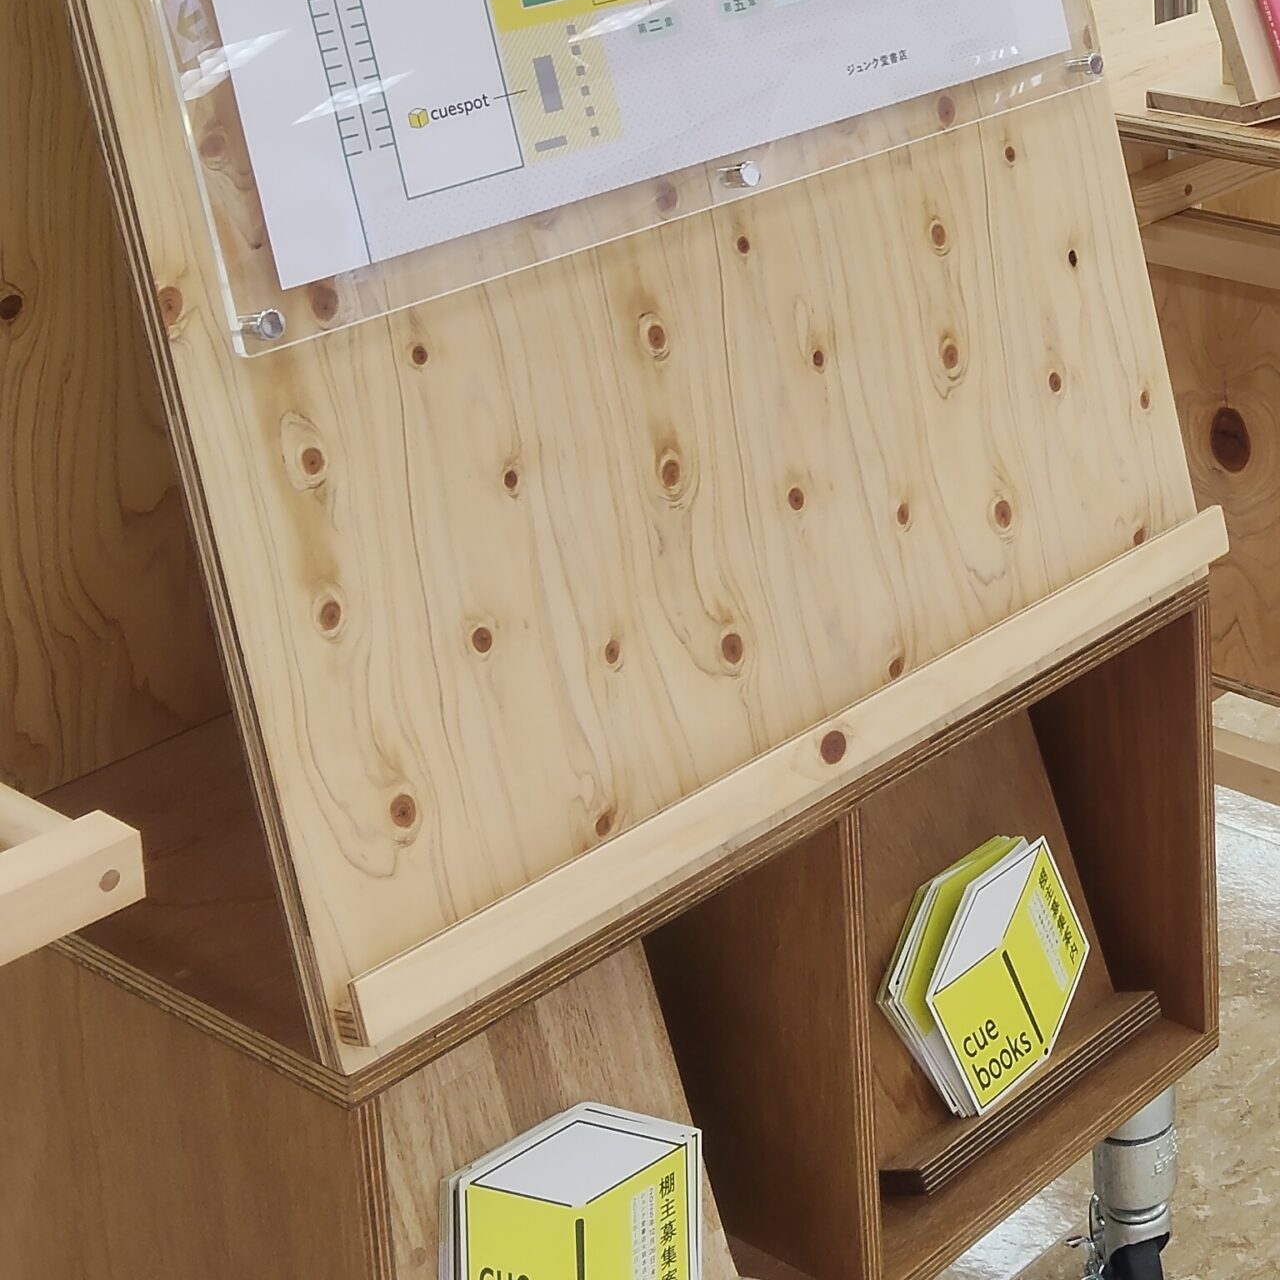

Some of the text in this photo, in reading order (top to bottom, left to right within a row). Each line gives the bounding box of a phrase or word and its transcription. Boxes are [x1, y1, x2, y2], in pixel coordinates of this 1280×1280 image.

[637, 16, 674, 35] 第二章
[847, 49, 908, 76] ジュンク堂書店
[430, 93, 490, 121] cuespot
[962, 1018, 1000, 1058] cue
[972, 1029, 1032, 1091] books
